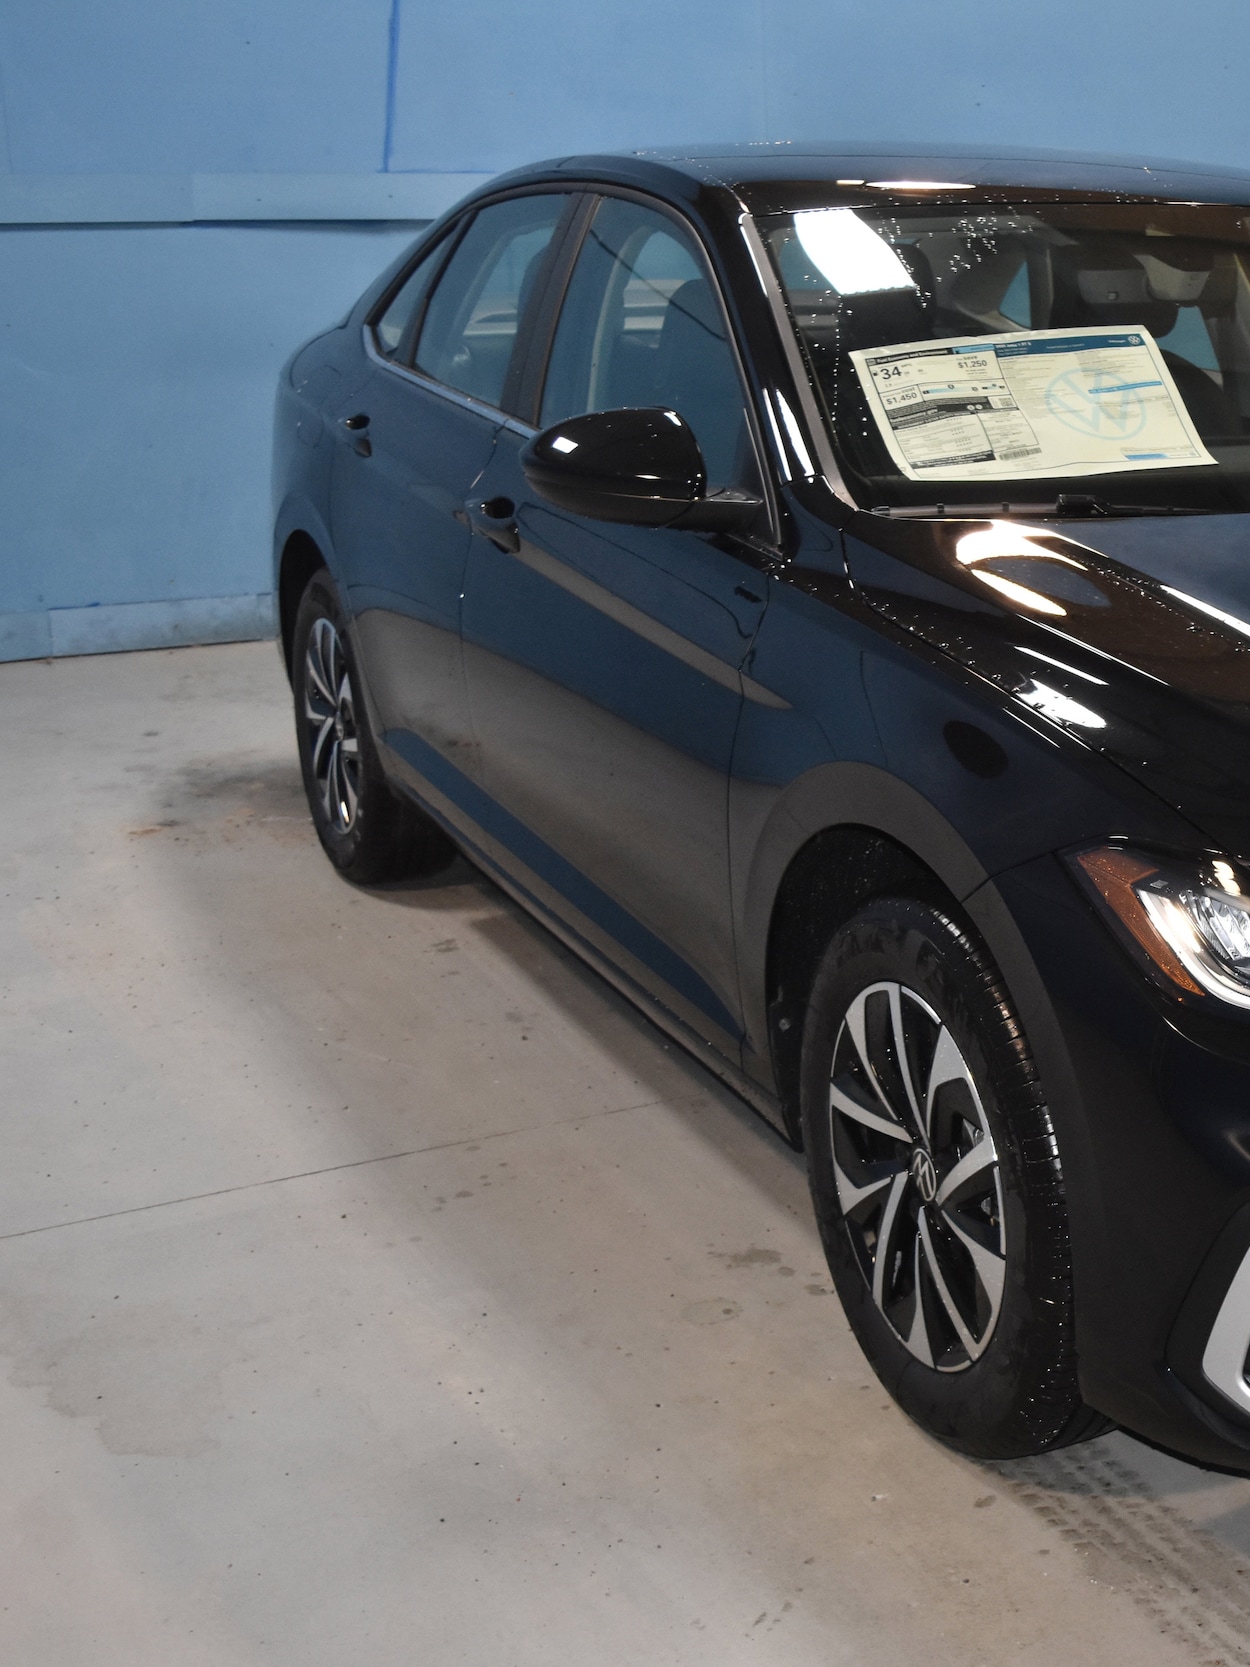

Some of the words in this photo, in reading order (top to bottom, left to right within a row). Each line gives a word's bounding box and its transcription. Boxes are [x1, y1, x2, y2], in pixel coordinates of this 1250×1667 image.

[958, 359, 987, 369] $1,250
[880, 366, 902, 380] 34
[886, 392, 917, 405] $1,450
